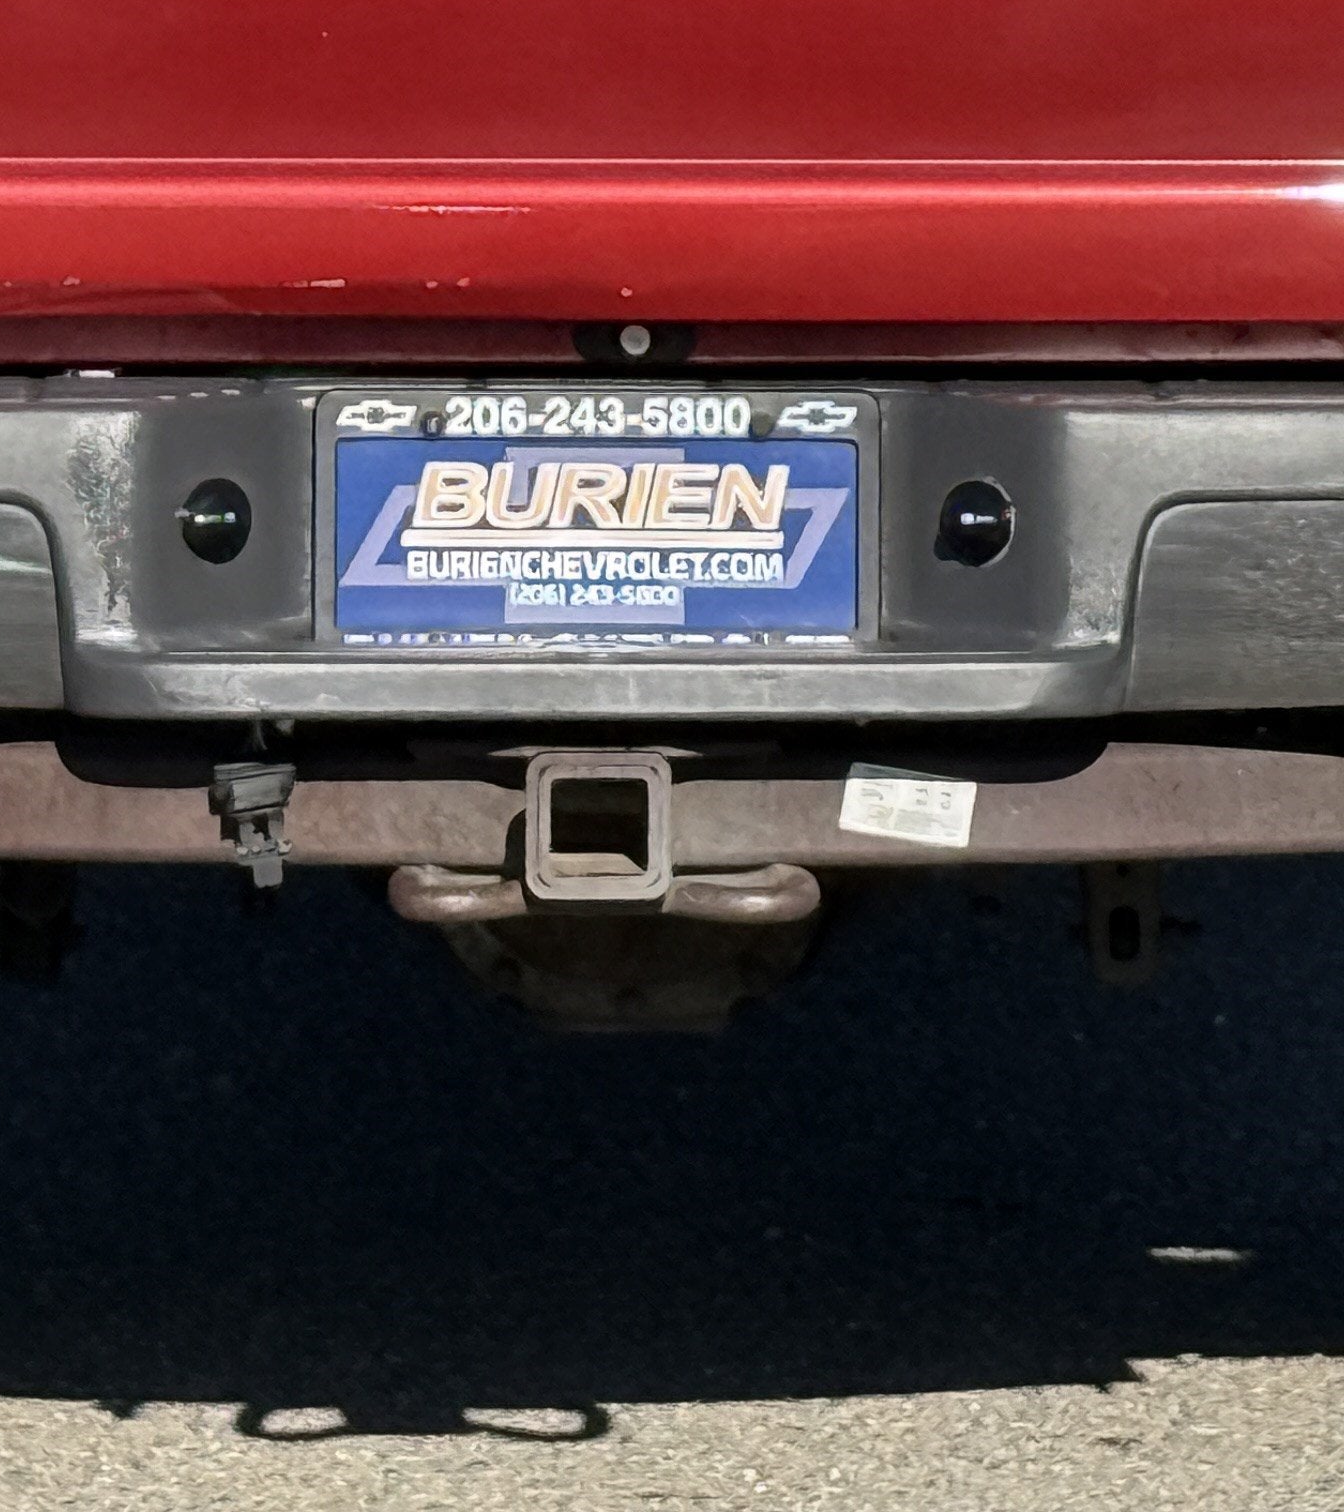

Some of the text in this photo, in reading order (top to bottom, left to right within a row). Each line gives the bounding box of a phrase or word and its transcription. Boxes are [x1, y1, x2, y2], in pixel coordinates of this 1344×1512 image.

[445, 396, 751, 438] 206-243-5800
[412, 461, 790, 530] BURIEN
[407, 550, 784, 581] BURIENCHEVROLET.COM
